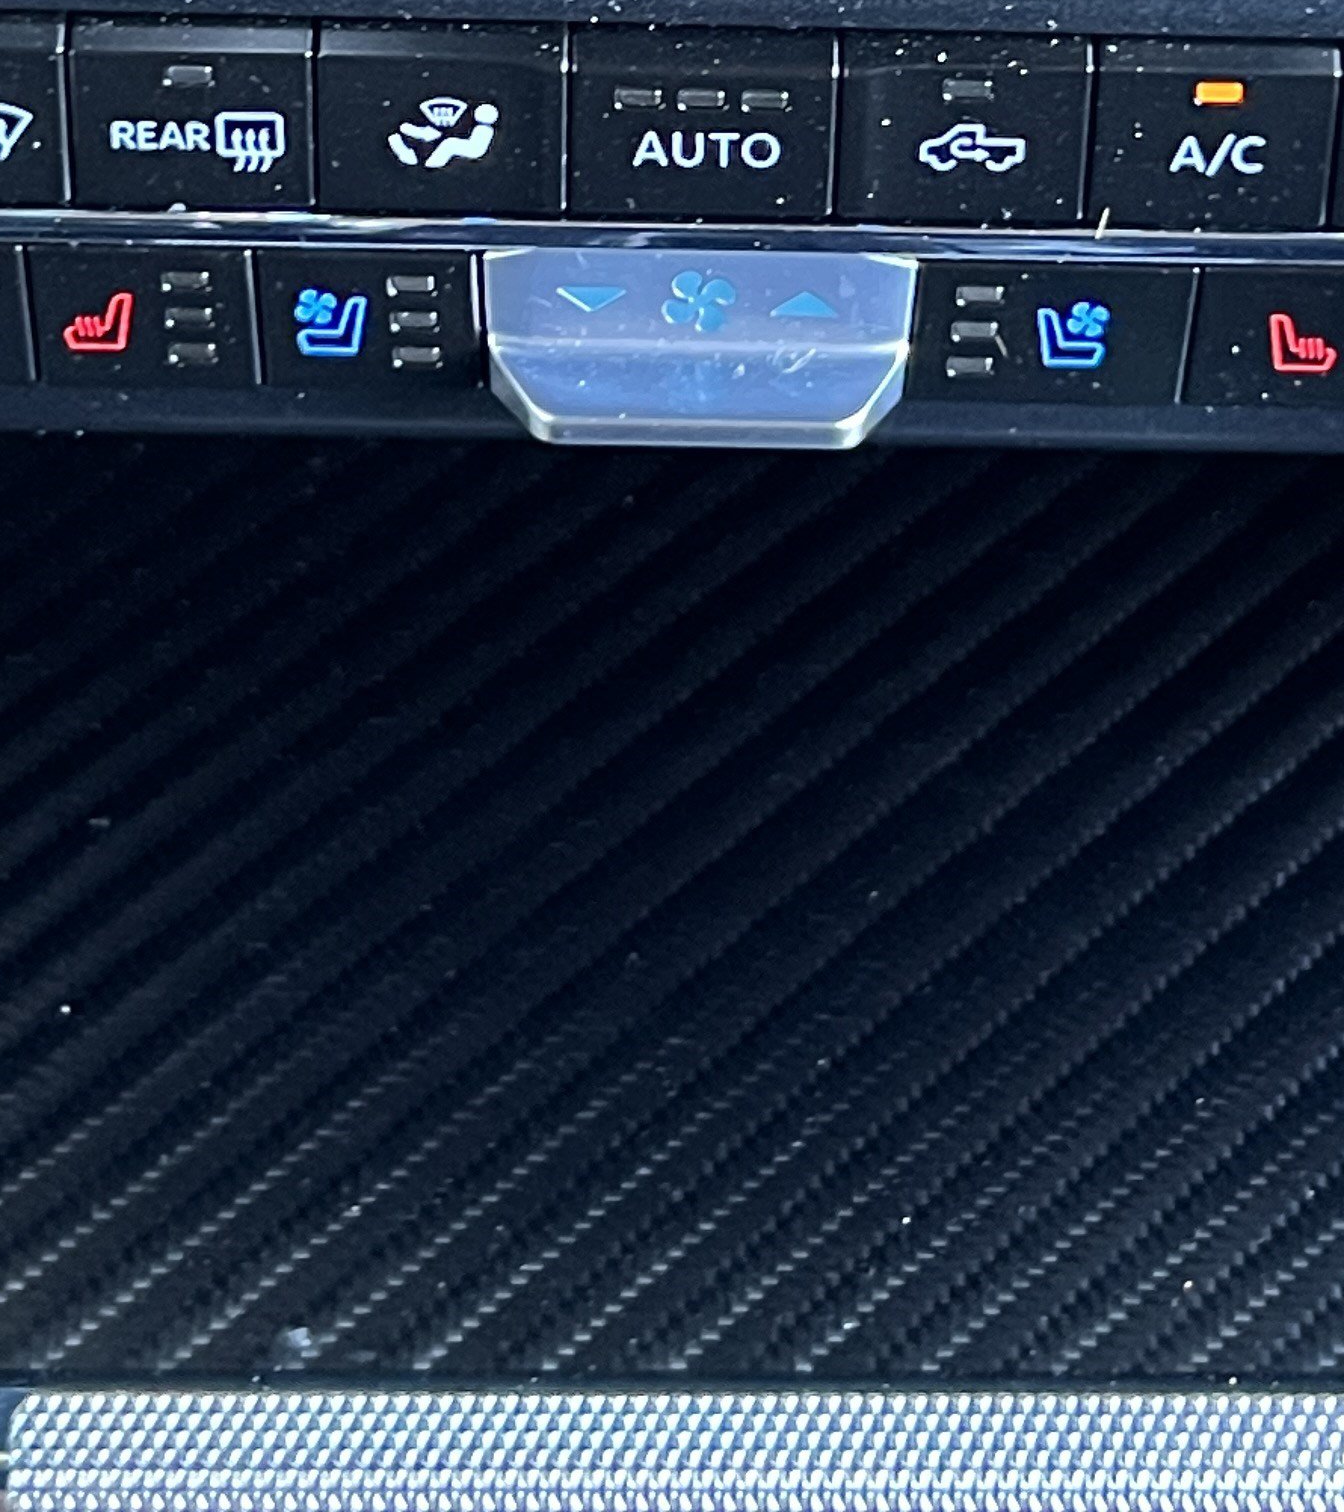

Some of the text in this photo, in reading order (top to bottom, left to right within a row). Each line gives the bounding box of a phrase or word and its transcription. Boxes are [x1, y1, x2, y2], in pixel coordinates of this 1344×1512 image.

[109, 119, 212, 152] REAR
[632, 130, 782, 169] AUTO
[1168, 135, 1267, 176] A/C
